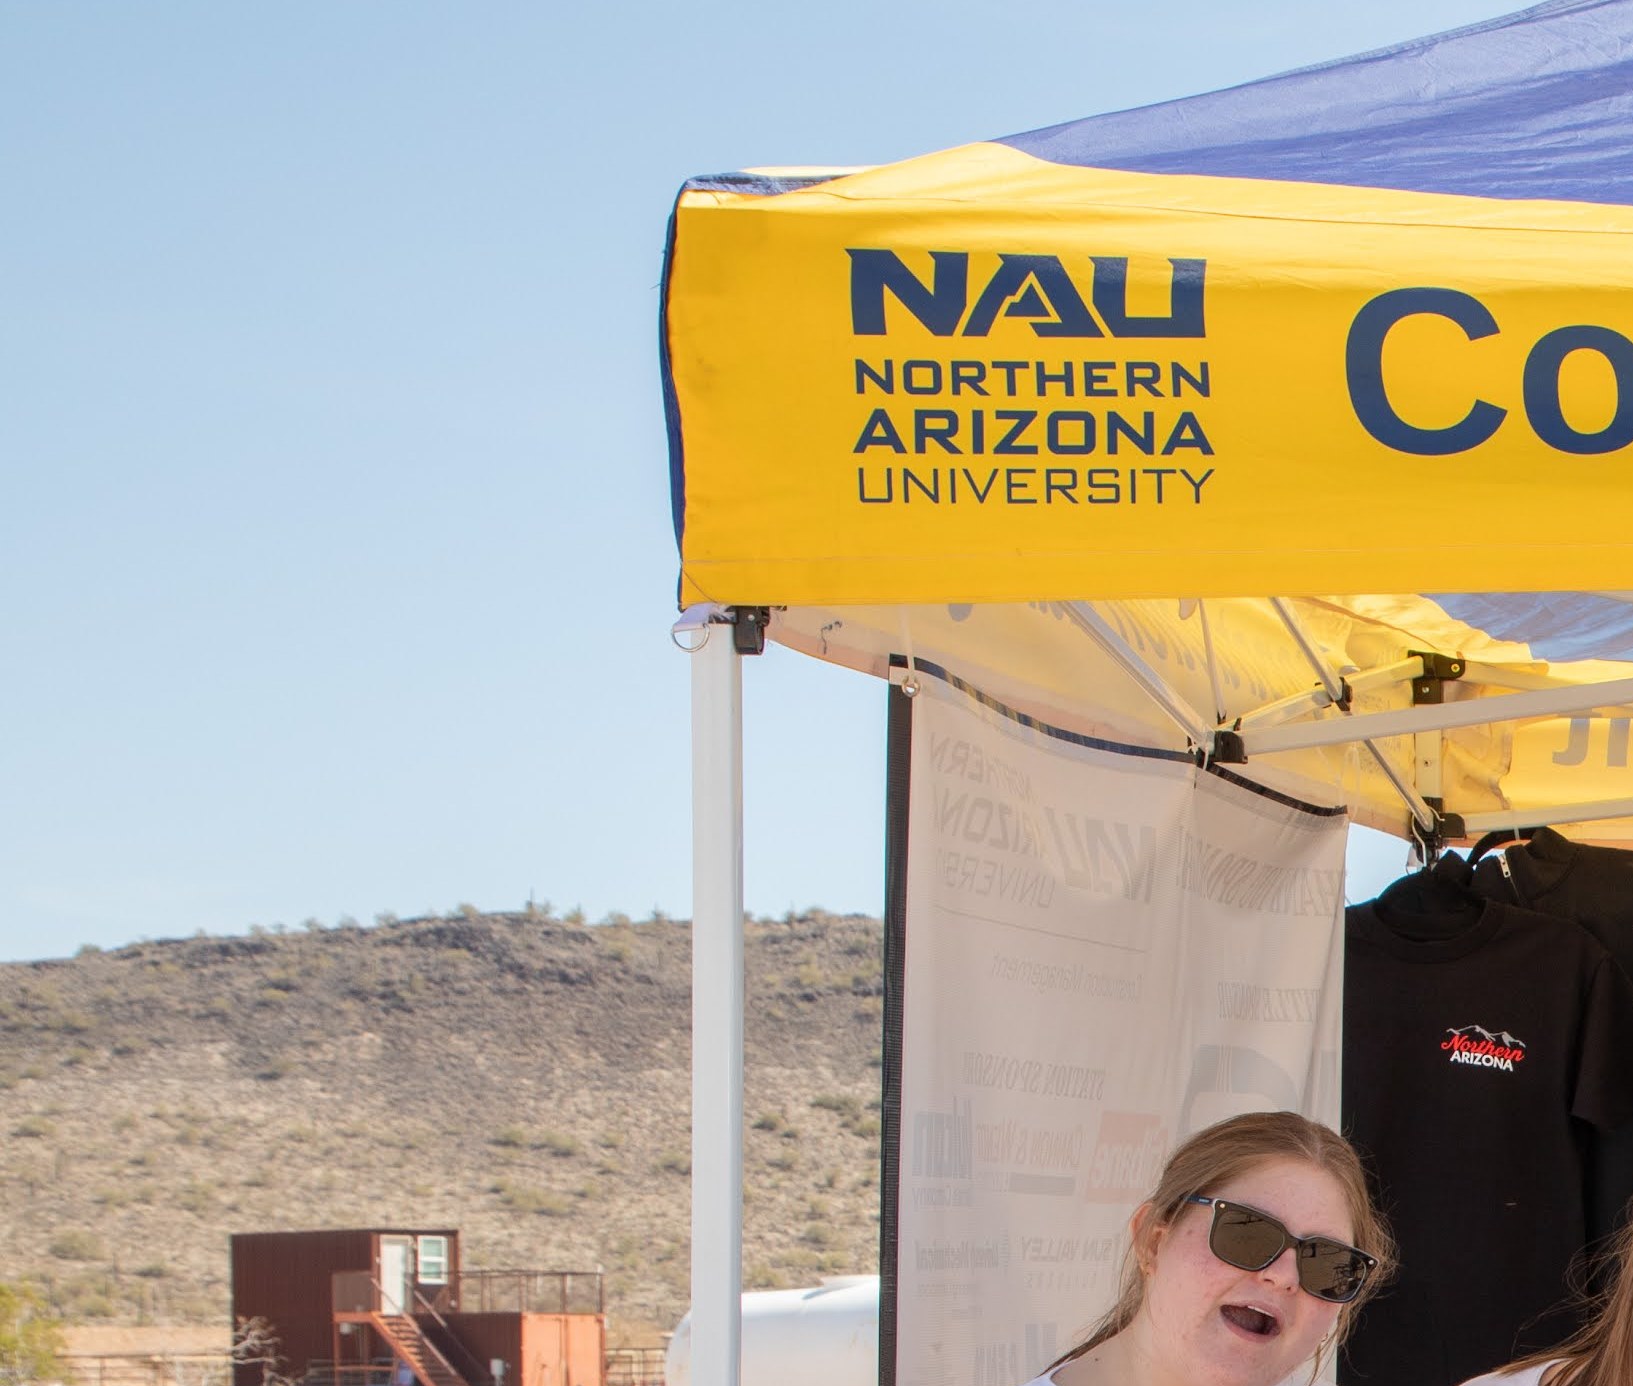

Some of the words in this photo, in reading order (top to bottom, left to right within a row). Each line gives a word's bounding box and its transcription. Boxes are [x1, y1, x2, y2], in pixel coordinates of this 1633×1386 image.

[845, 249, 1208, 339] NAU
[854, 359, 1212, 399] NORTHERN
[853, 410, 1216, 456] ARIZONA
[858, 468, 1216, 505] UNIVERSITY
[1441, 1034, 1524, 1062] Northern
[1451, 1050, 1513, 1072] ARIZONA
